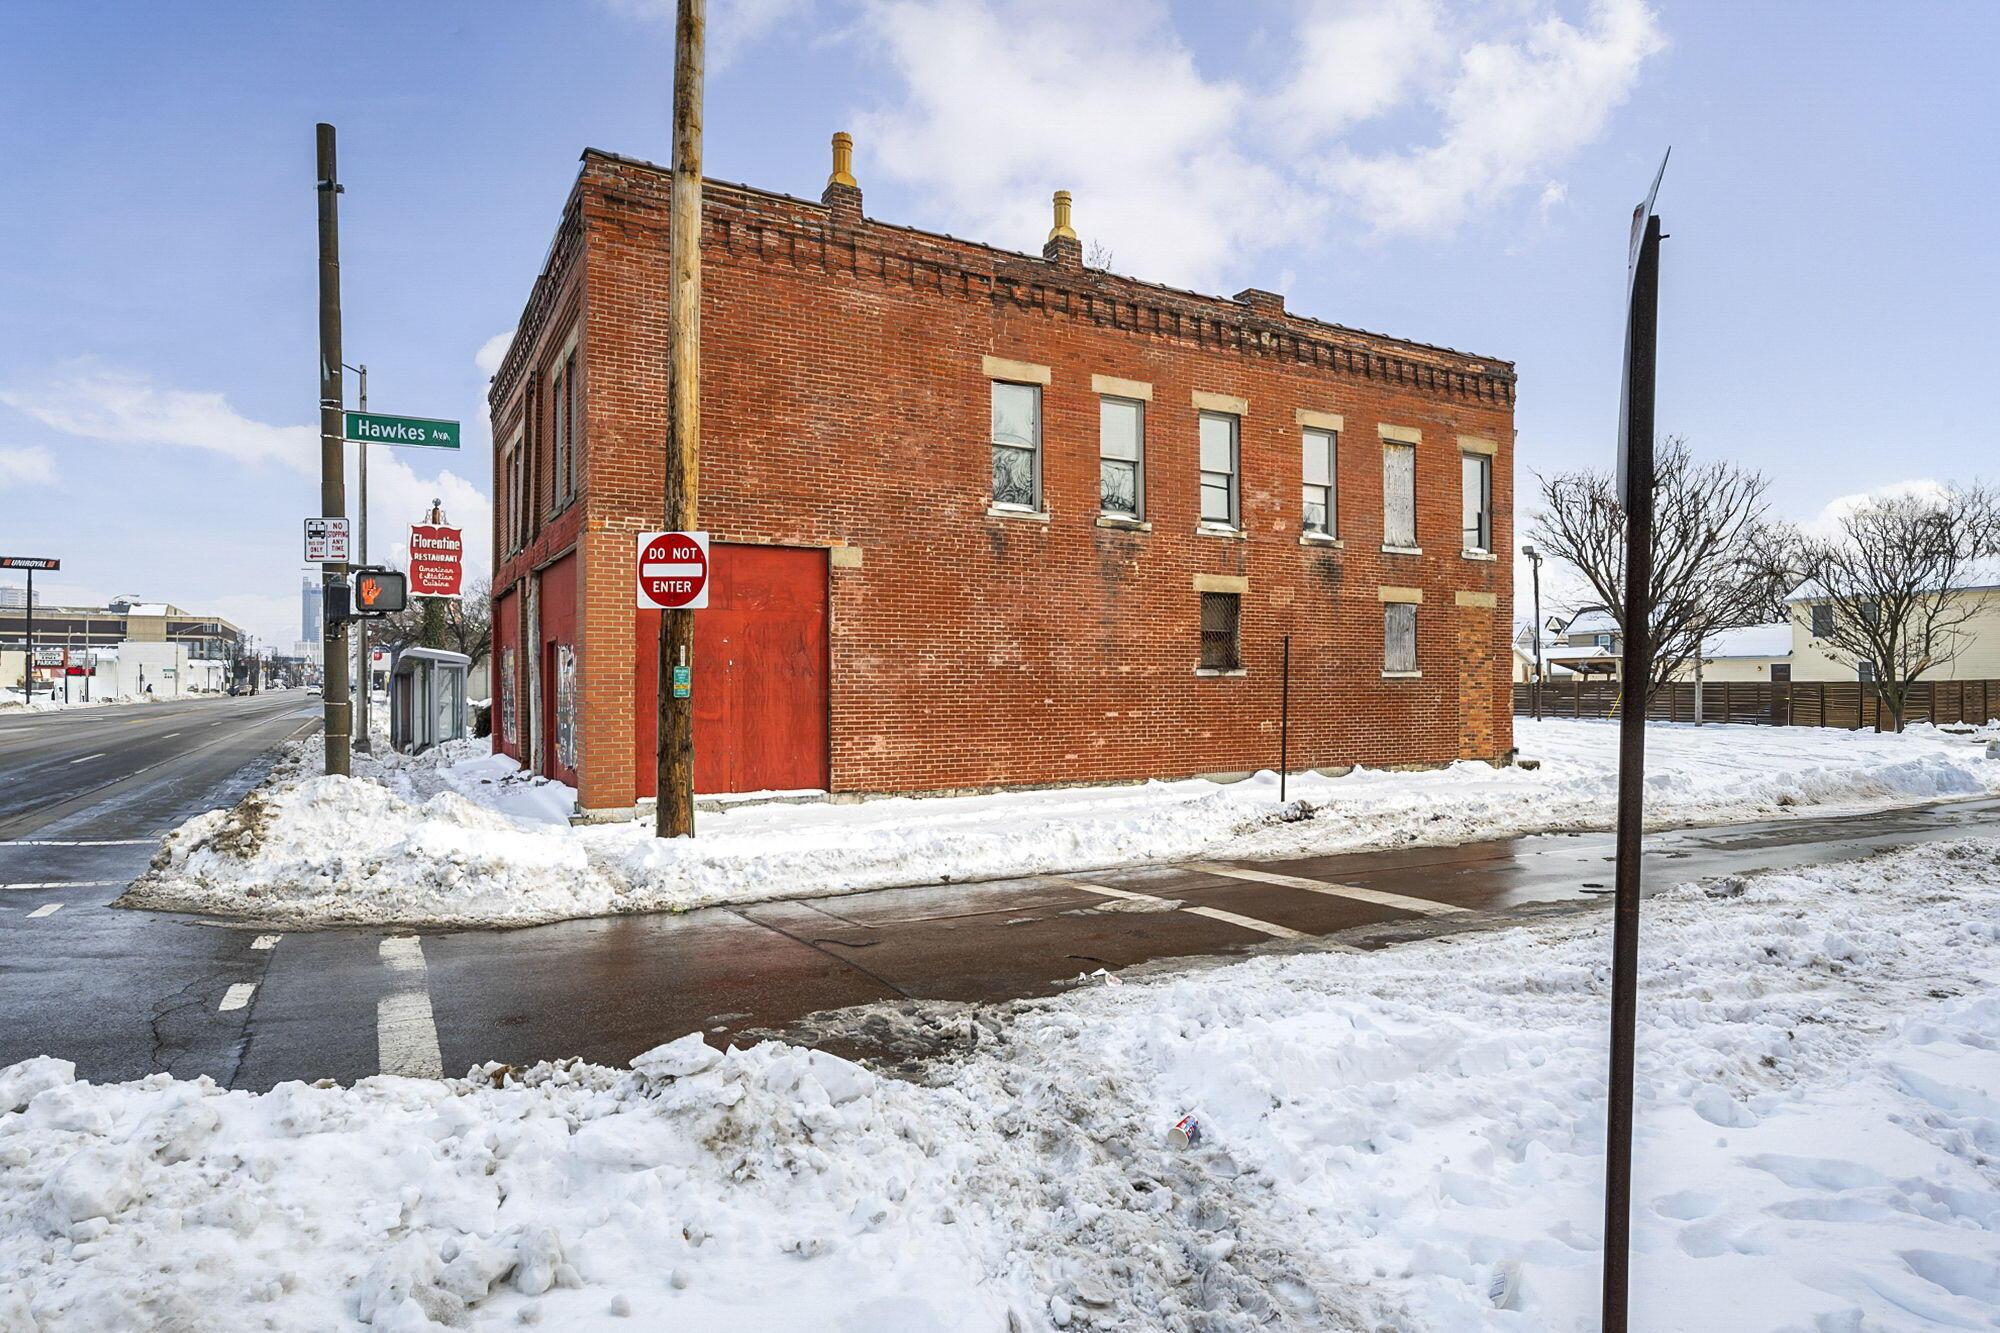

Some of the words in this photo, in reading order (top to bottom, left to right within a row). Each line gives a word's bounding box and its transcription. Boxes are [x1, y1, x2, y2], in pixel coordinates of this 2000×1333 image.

[358, 419, 425, 441] Hawkes
[332, 522, 343, 530] NO
[412, 533, 460, 550] Florentine
[414, 553, 457, 562] RESTAURANT
[649, 547, 666, 560] DO
[672, 547, 698, 560] NOT
[11, 559, 47, 567] UNIROYAL
[418, 564, 454, 573] American
[422, 579, 449, 587] Cuisine
[653, 580, 692, 593] ENTER
